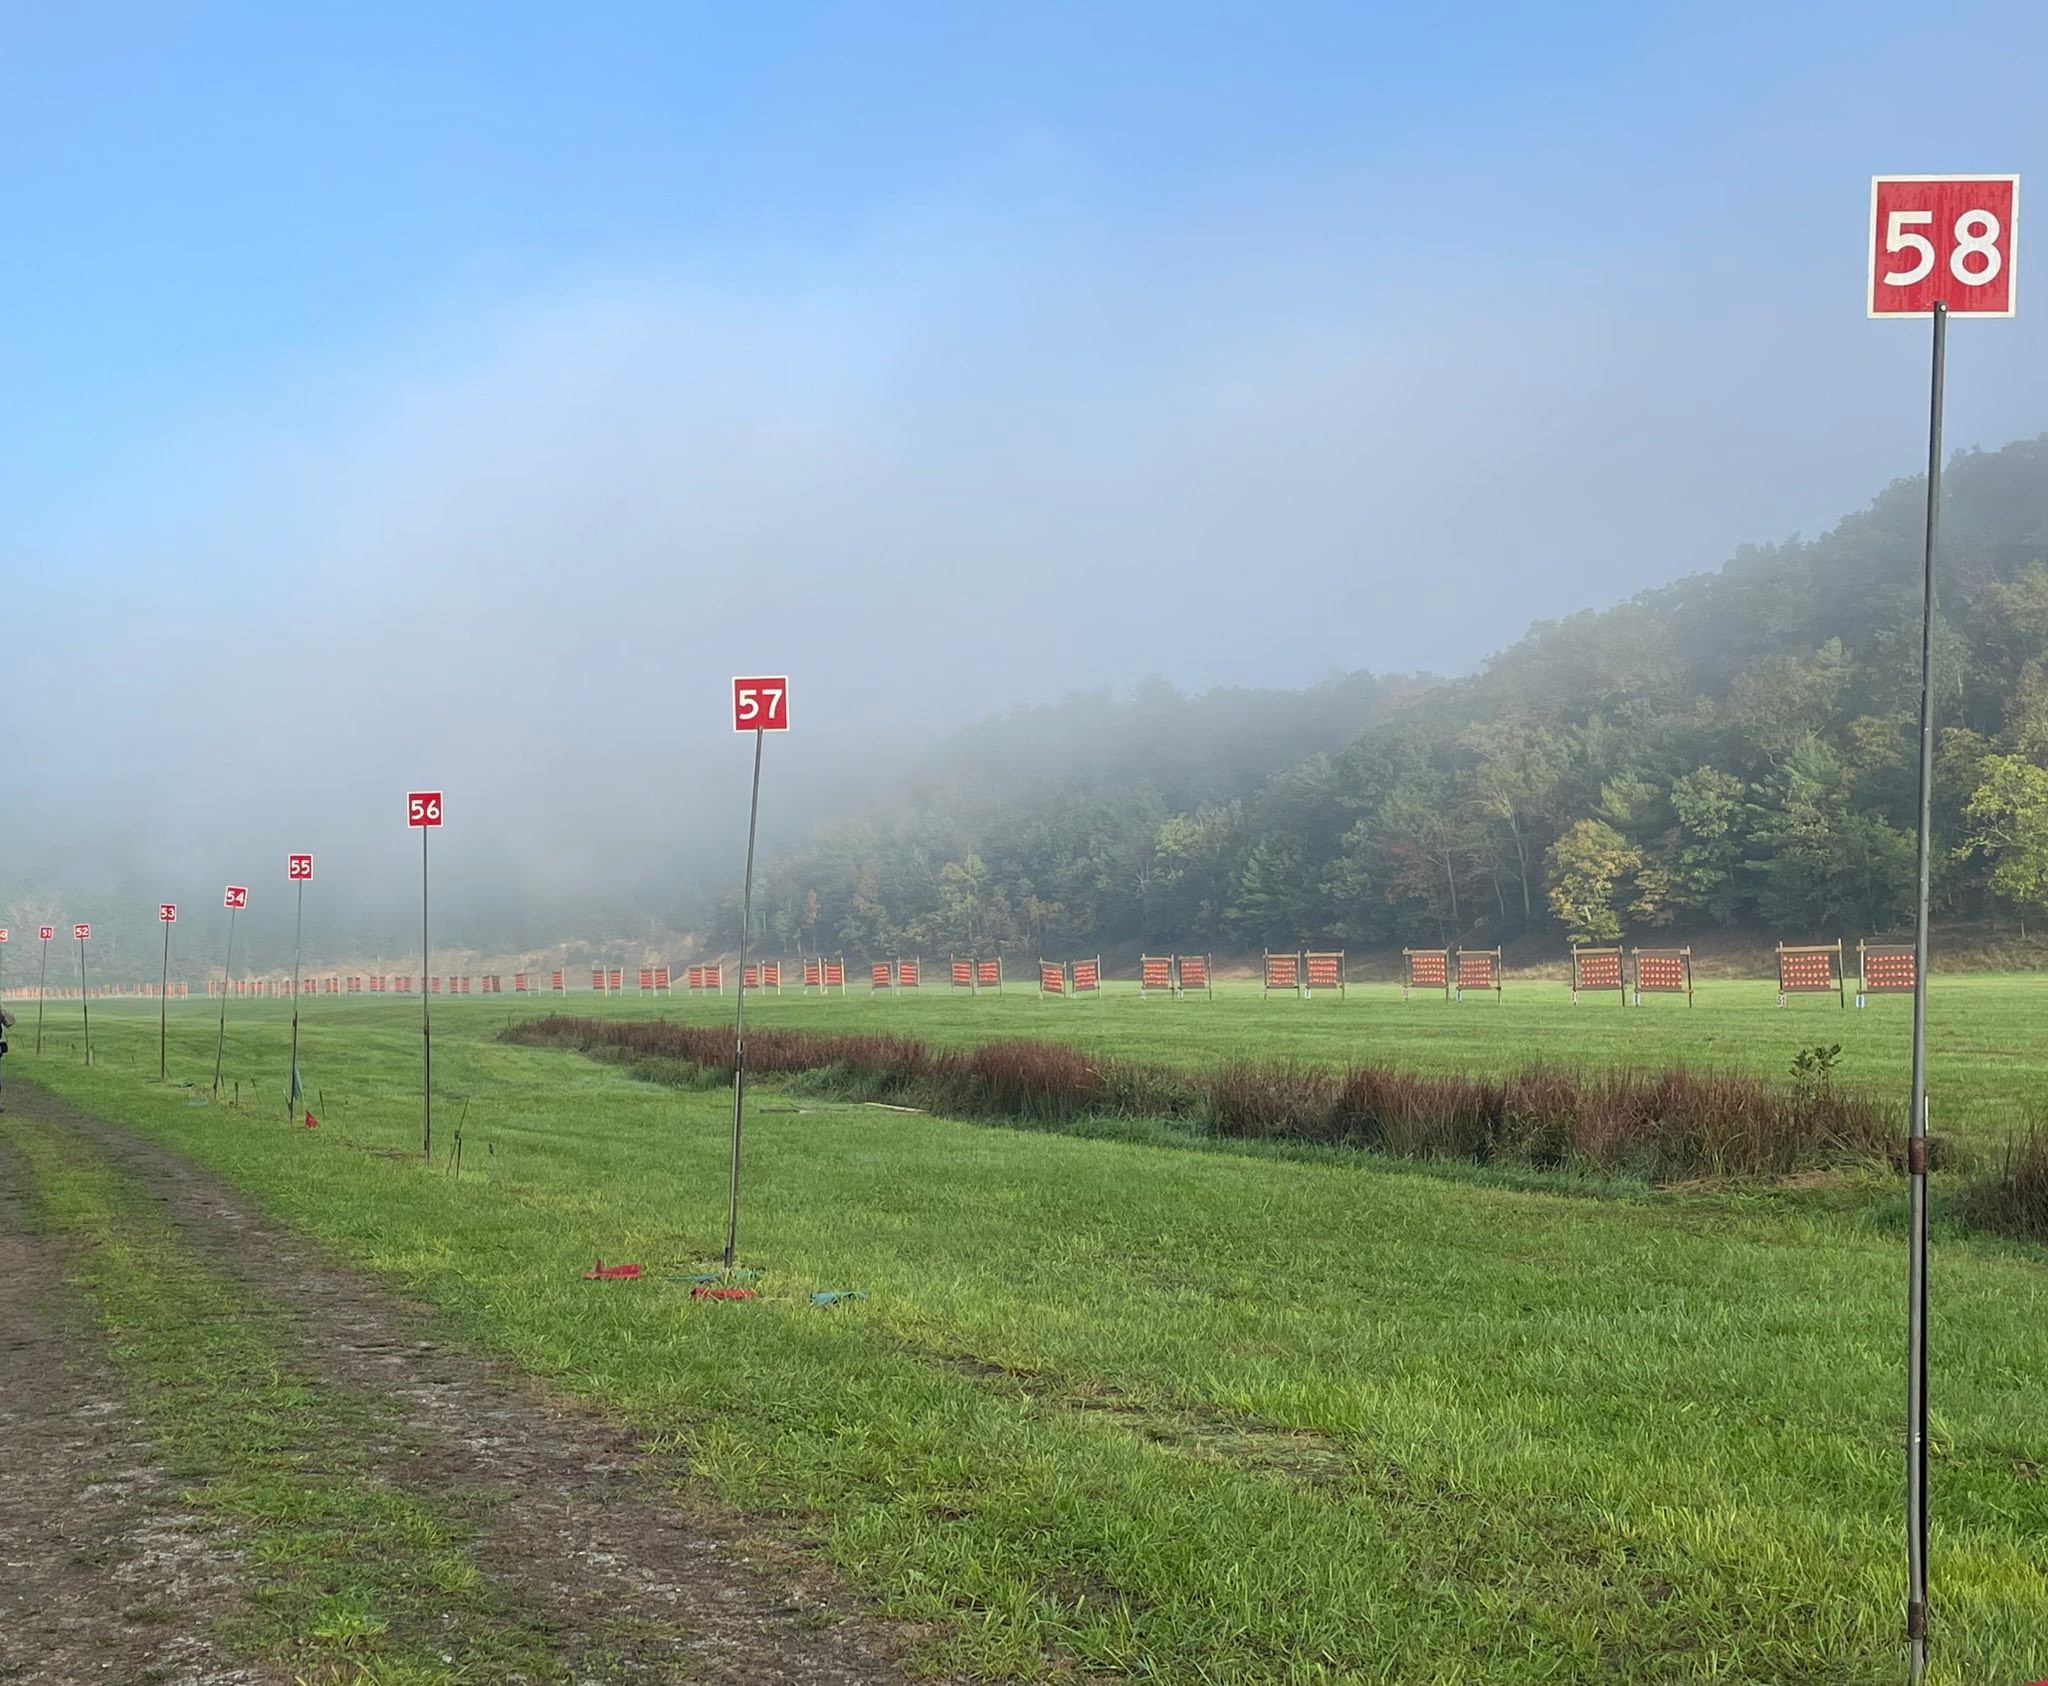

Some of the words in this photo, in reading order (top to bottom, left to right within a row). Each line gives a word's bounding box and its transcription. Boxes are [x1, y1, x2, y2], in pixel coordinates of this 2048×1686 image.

[1883, 209, 2002, 286] 58
[739, 688, 783, 720] 57
[411, 799, 440, 820] 56
[291, 860, 311, 875] 55
[226, 890, 245, 904] 54
[161, 907, 175, 918] 53
[42, 928, 51, 937] 51
[76, 927, 89, 937] 52
